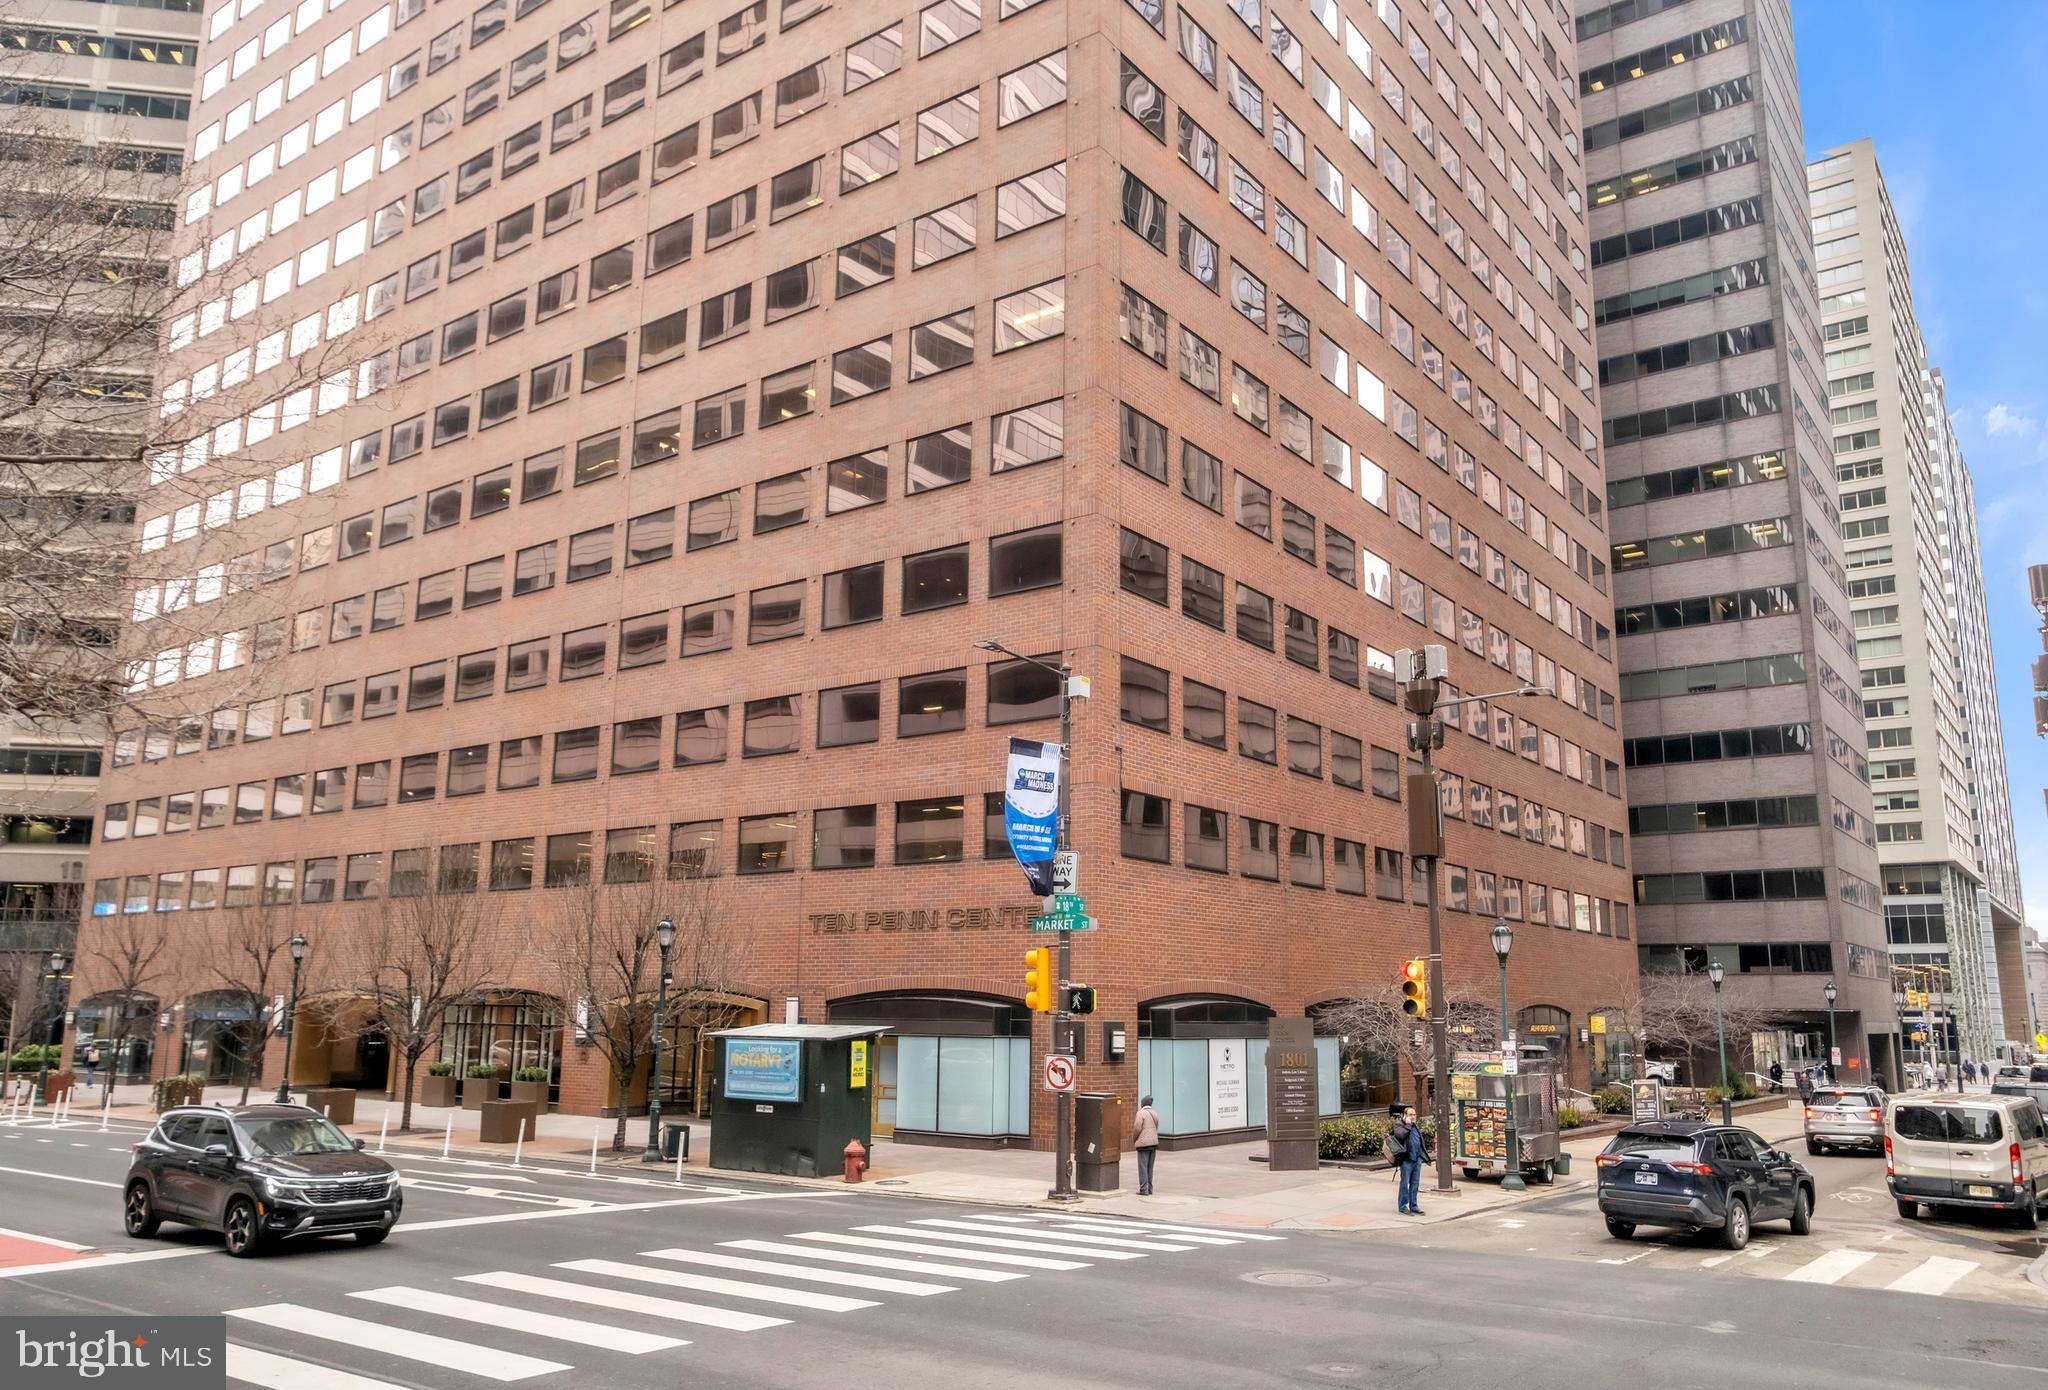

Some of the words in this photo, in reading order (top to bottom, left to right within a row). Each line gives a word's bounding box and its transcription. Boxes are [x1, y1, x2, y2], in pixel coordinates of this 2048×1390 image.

[1025, 770, 1046, 781] MARCH
[1027, 779, 1054, 791] MADNESS
[809, 912, 857, 932] TEN
[864, 909, 939, 931] PENN
[946, 905, 1043, 929] CENTE
[1036, 919, 1074, 931] MARKET
[1081, 920, 1088, 929] ST
[1280, 1053, 1308, 1067] 1801
